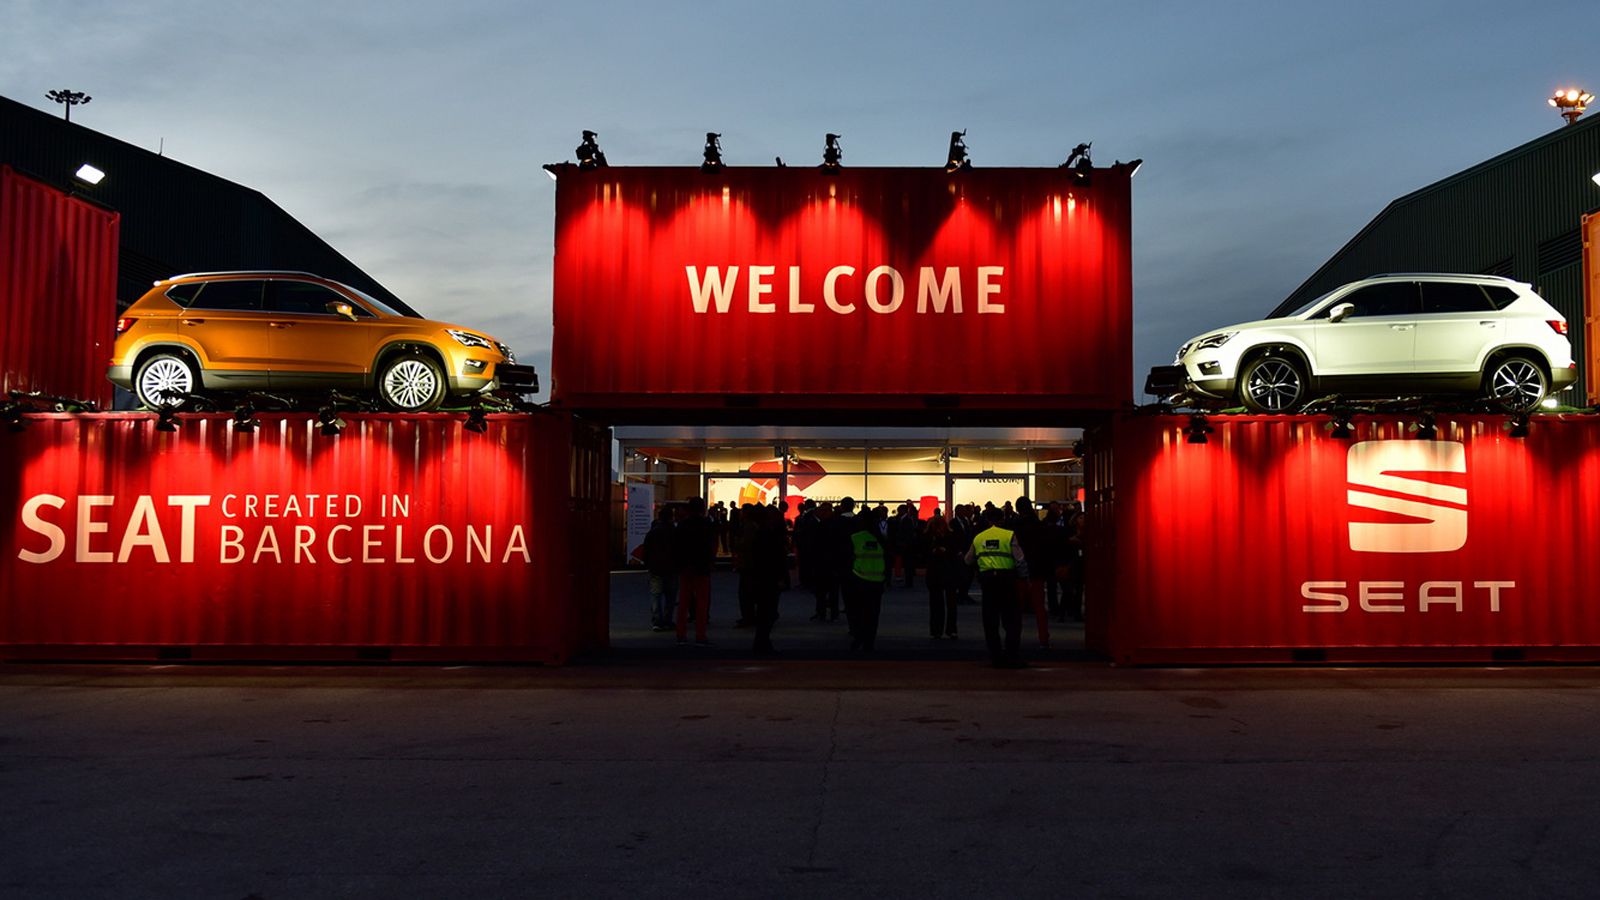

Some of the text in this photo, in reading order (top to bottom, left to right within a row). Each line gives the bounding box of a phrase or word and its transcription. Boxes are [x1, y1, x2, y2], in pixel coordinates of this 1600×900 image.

[686, 265, 1005, 314] WELCOME
[221, 494, 409, 518] CREATED IN
[18, 493, 211, 563] SEAT
[220, 525, 532, 564] BARCELONA
[1301, 581, 1516, 612] SEAT
